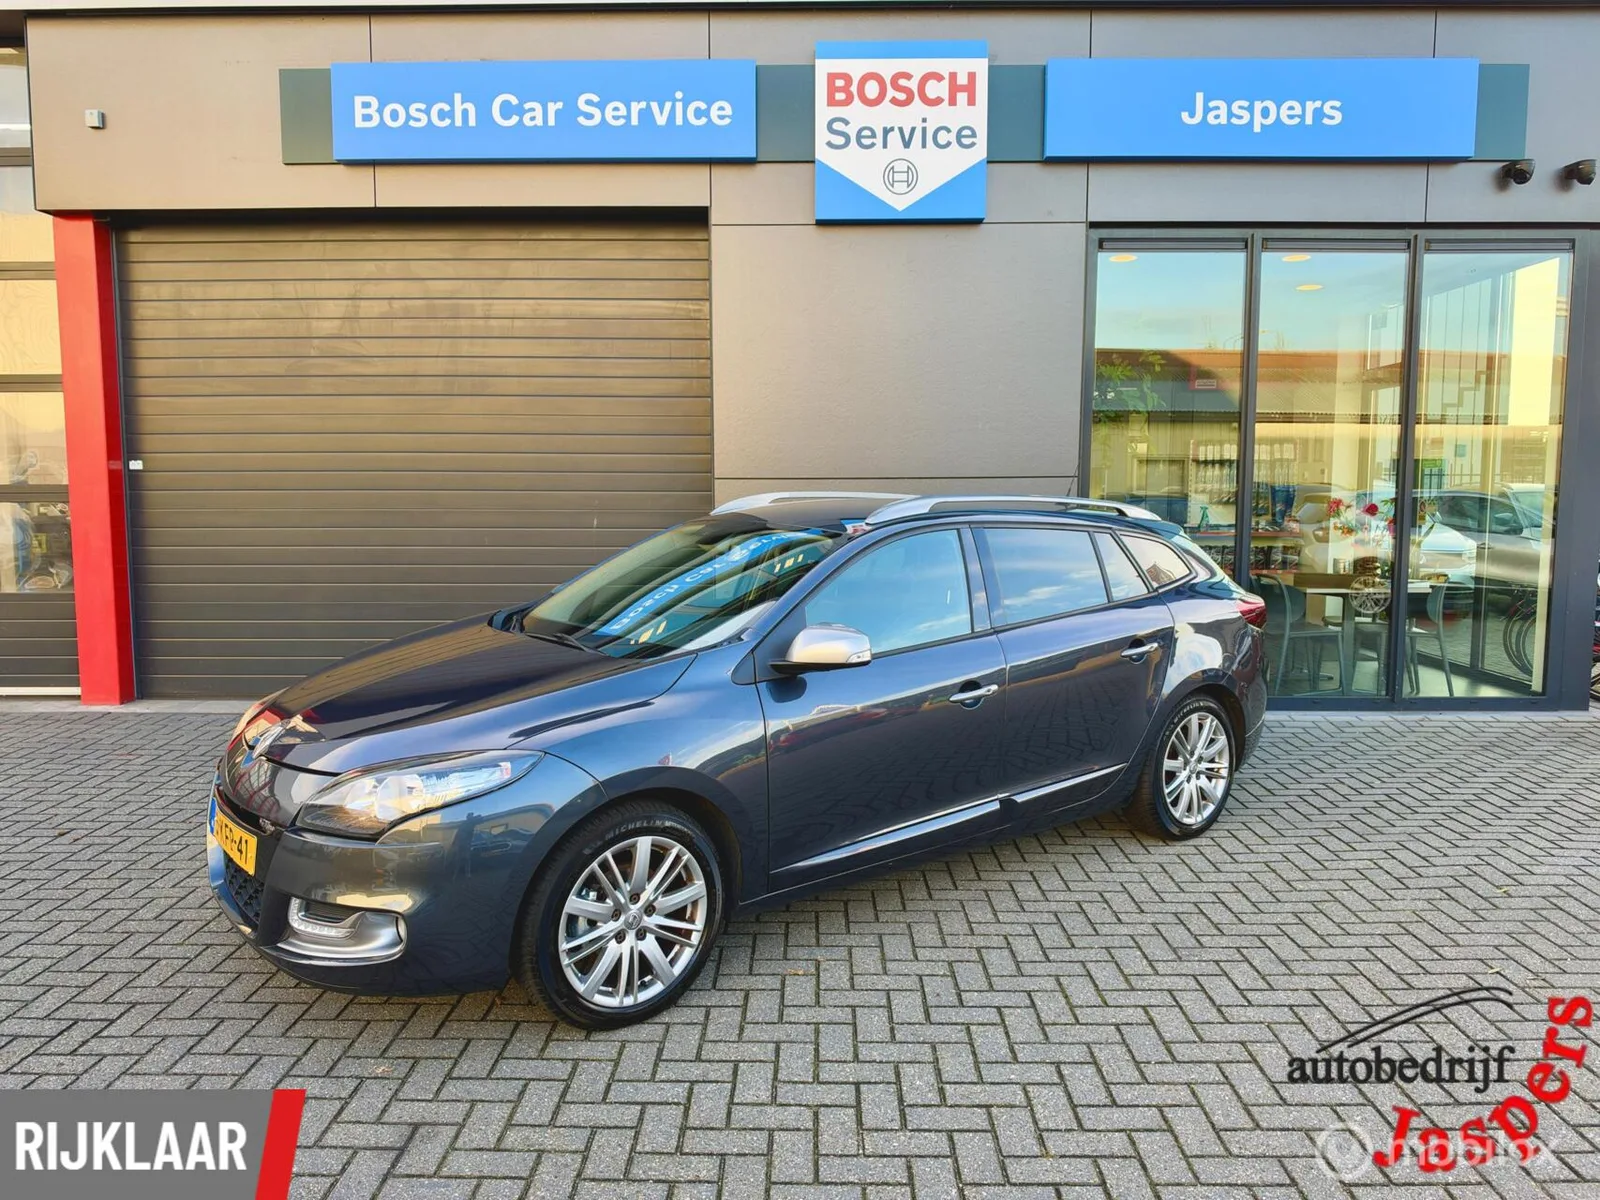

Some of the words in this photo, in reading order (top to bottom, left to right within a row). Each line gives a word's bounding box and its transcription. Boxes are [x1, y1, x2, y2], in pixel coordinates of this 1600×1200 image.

[827, 72, 976, 107] BOSCH
[354, 94, 477, 129] Bosch
[491, 93, 565, 127] Car
[576, 91, 734, 128] Service
[1180, 92, 1343, 133] Jaspers
[825, 117, 979, 151] Service
